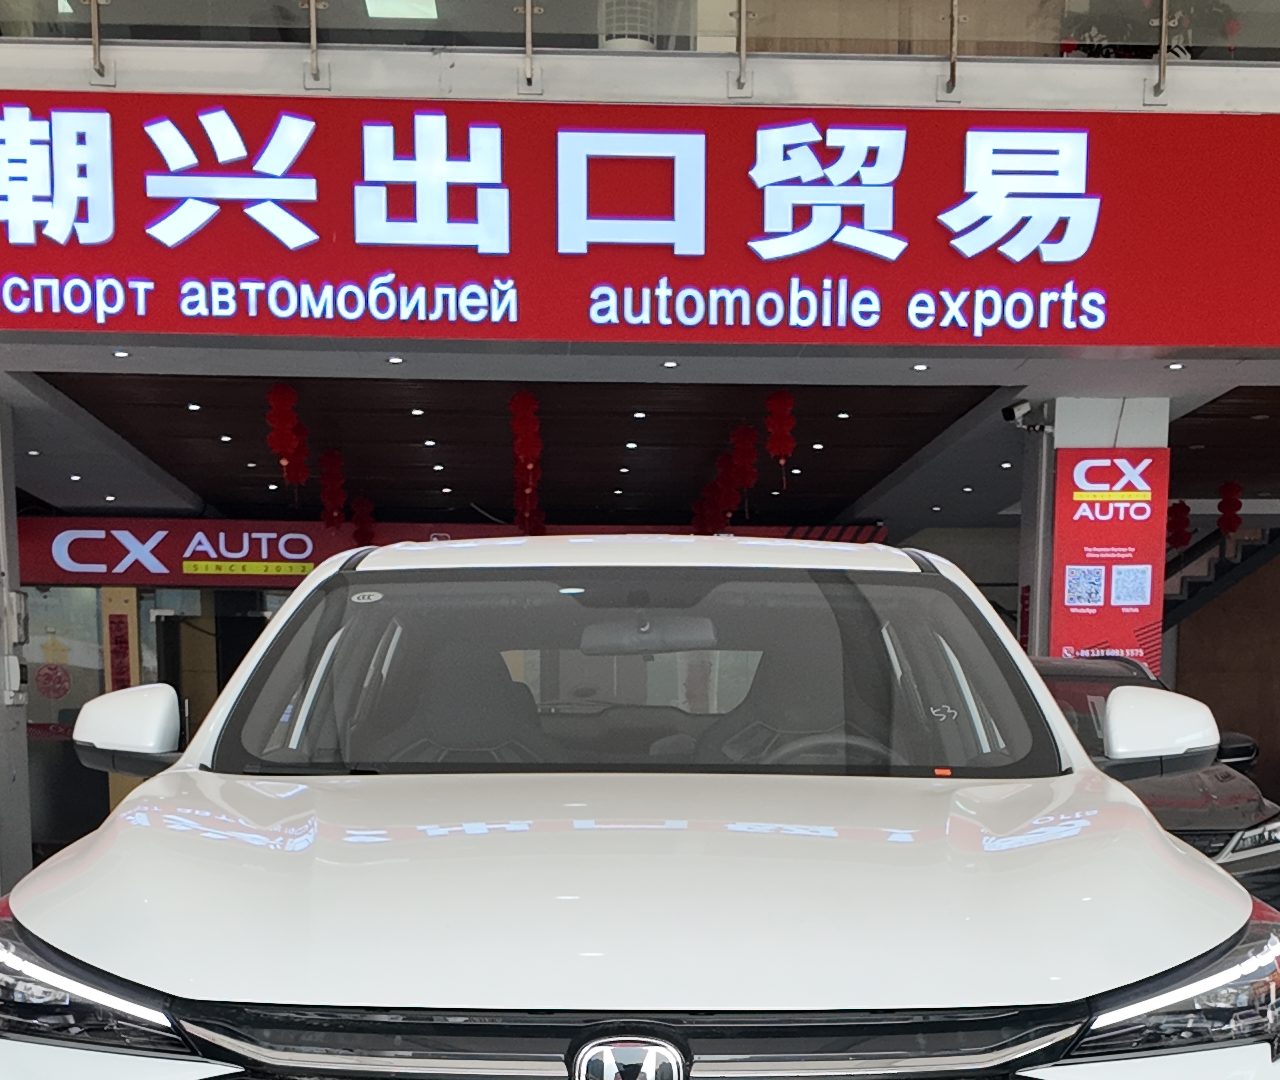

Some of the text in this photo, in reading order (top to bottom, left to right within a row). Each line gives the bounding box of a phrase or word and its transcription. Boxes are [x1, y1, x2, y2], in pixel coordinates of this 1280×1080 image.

[180, 272, 519, 323] автомобилей
[589, 275, 1107, 337] automobile exports
[1073, 458, 1152, 491] CX
[1073, 502, 1151, 520] AUTO
[51, 529, 314, 574] CX AUTO
[193, 564, 308, 573] SINCE 2012
[930, 705, 957, 721] 53
